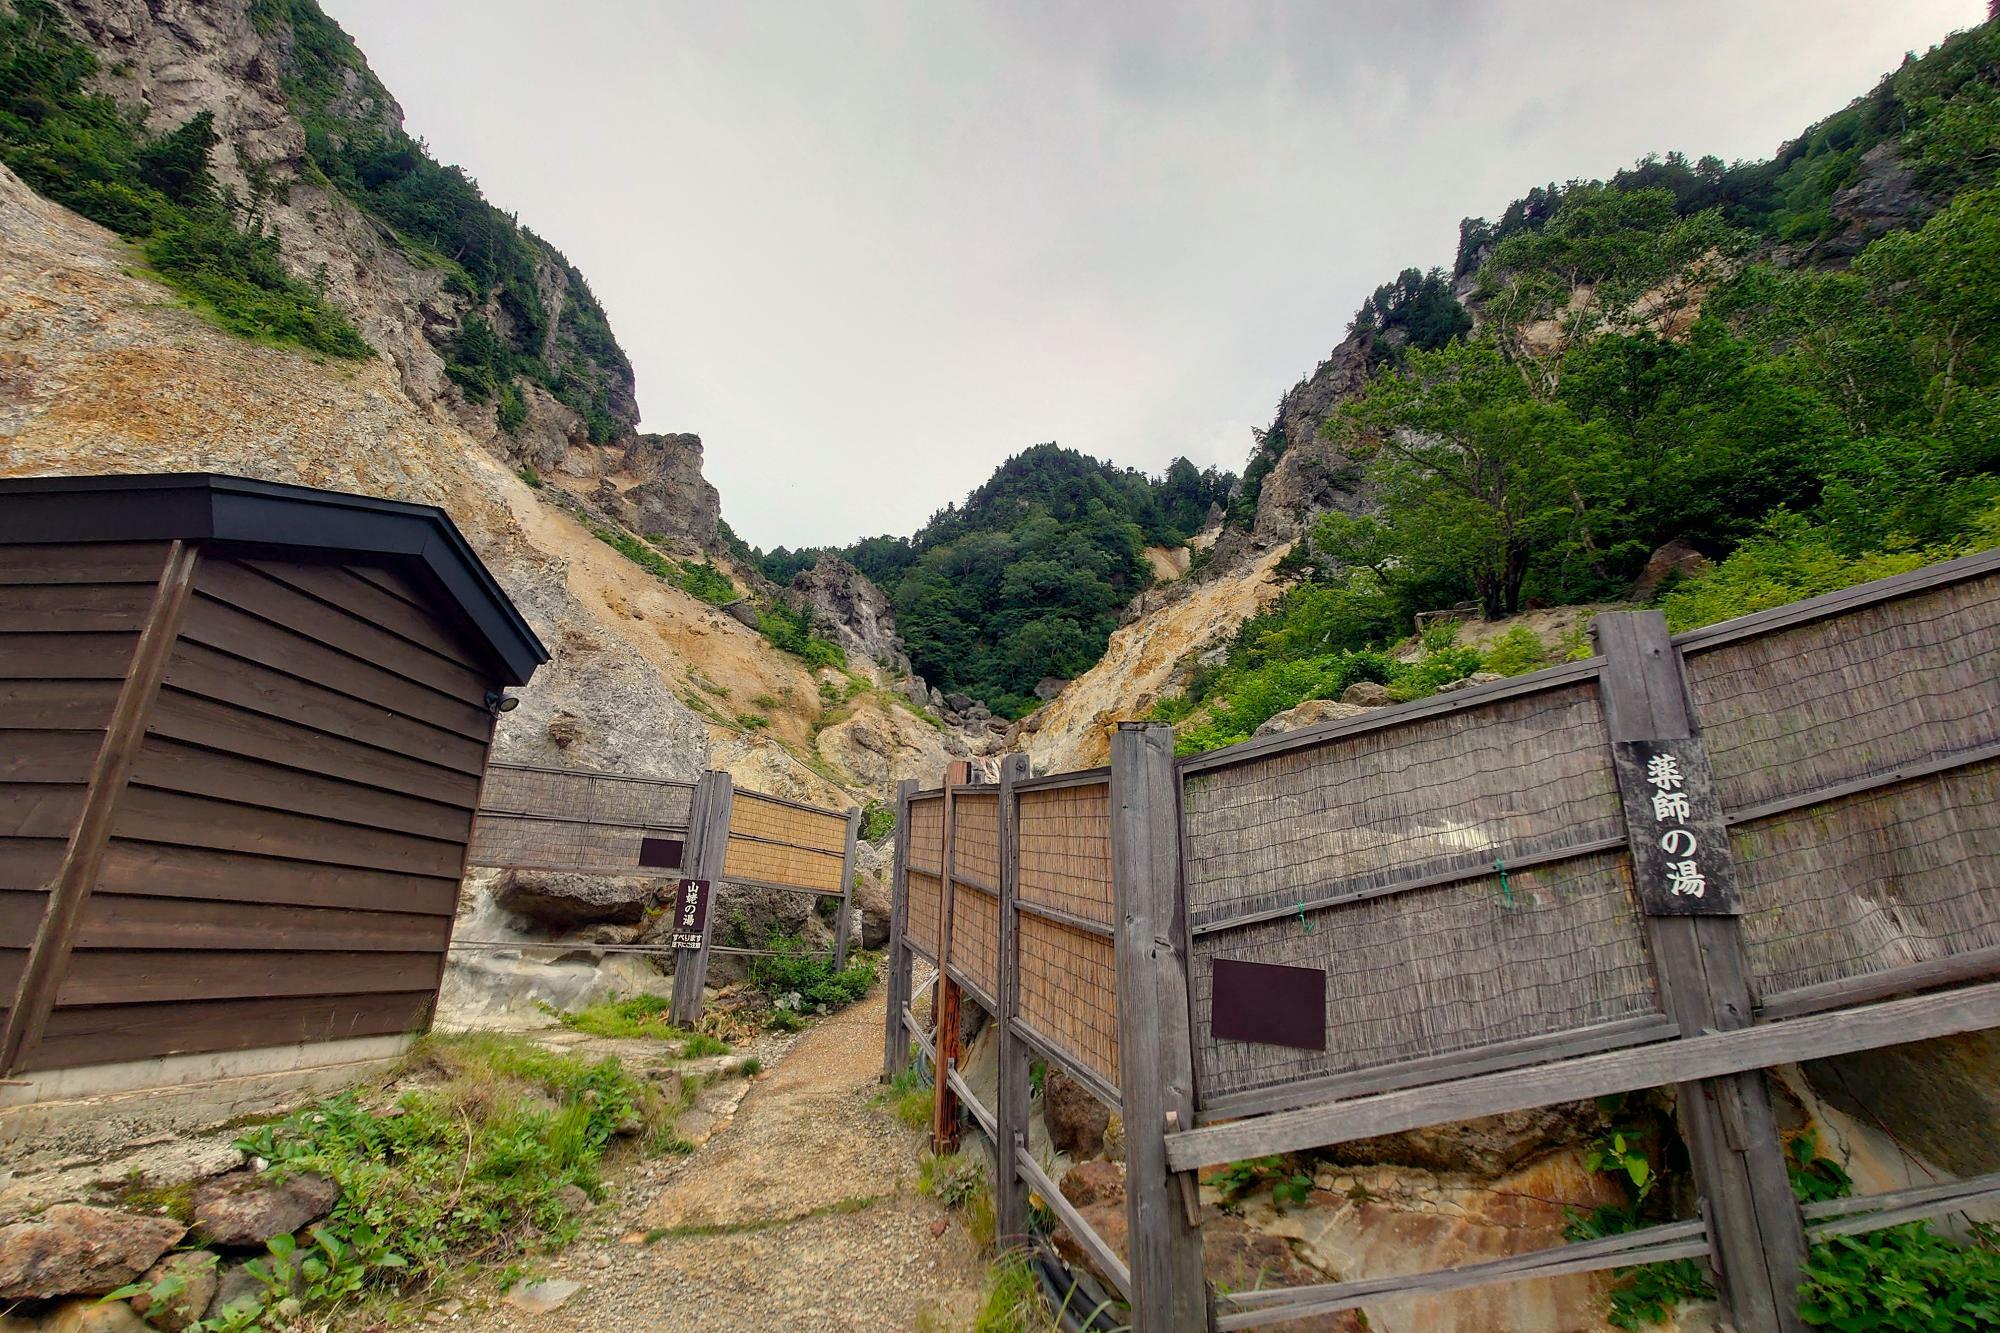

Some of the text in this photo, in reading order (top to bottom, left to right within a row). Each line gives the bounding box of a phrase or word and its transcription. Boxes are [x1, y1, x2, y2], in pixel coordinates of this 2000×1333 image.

[1646, 753, 1706, 899] 薬師の湯
[682, 881, 700, 927] 山姥の湯
